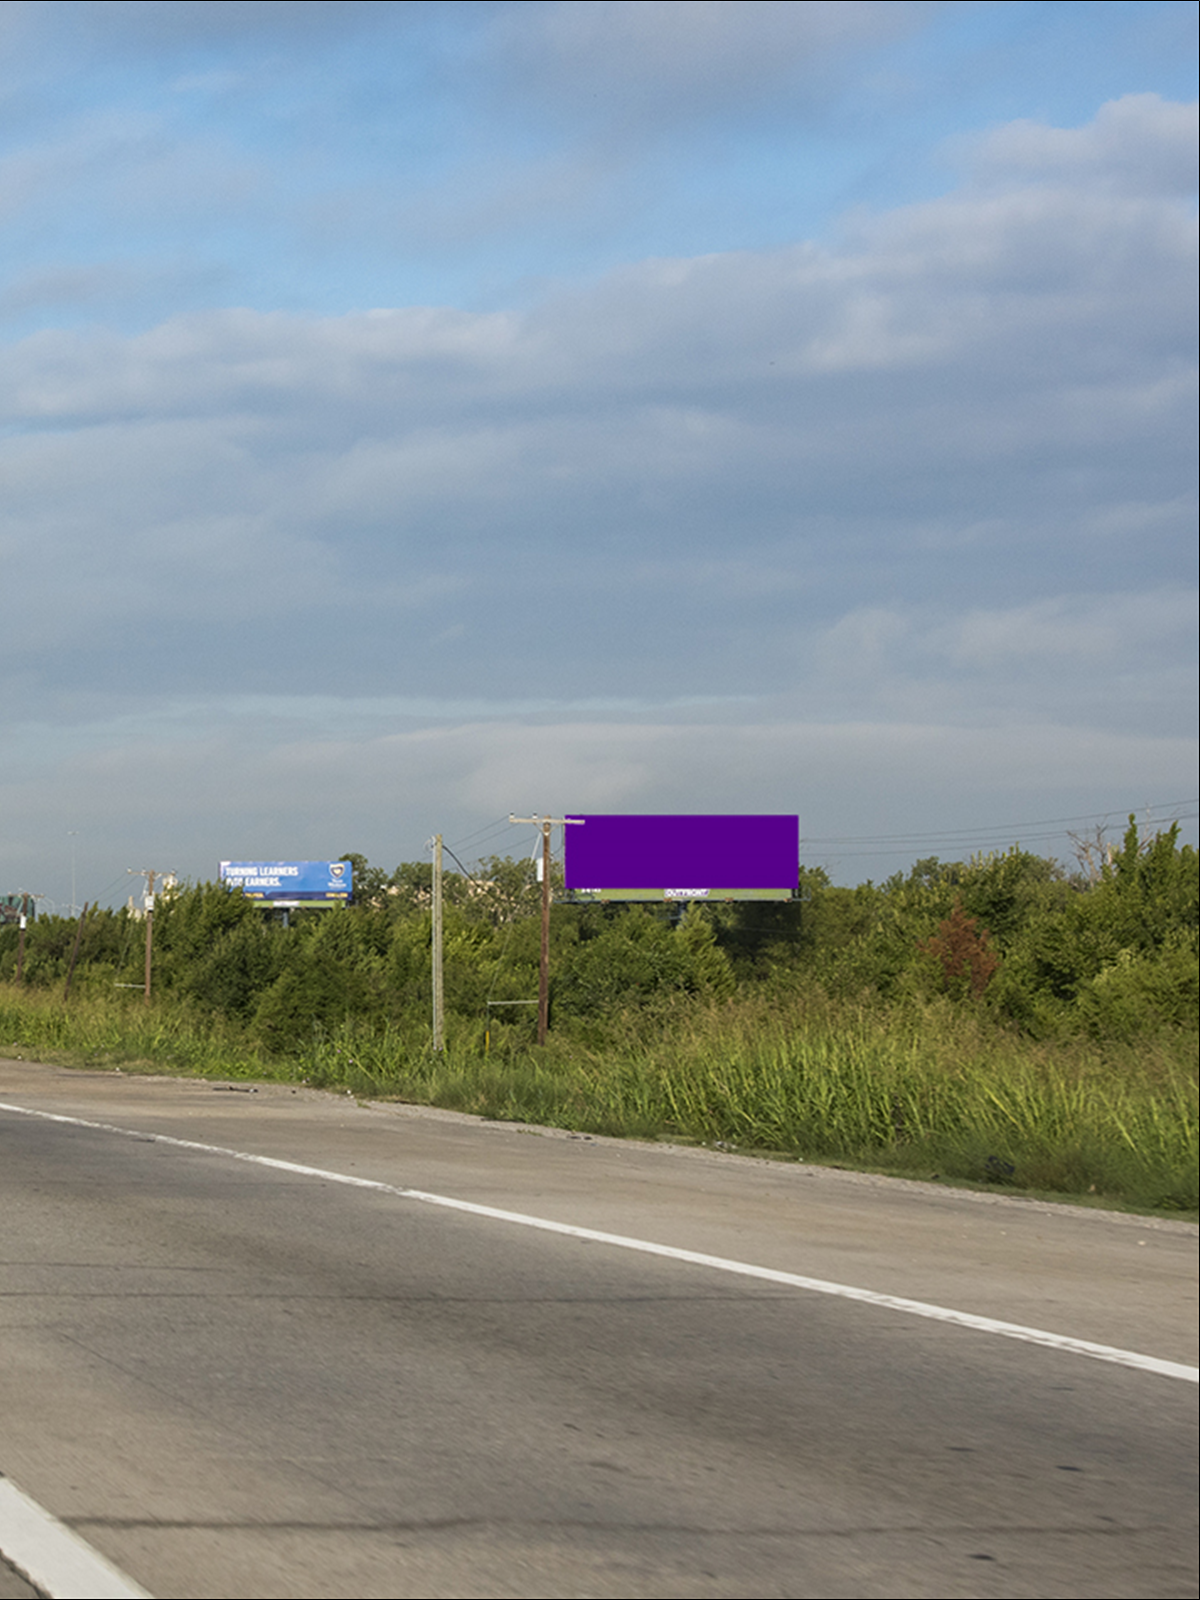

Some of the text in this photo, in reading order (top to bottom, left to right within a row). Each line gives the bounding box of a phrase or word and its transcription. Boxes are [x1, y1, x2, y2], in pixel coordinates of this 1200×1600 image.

[225, 866, 299, 876] TURNING LEARNERS
[245, 876, 282, 887] EARNERS.
